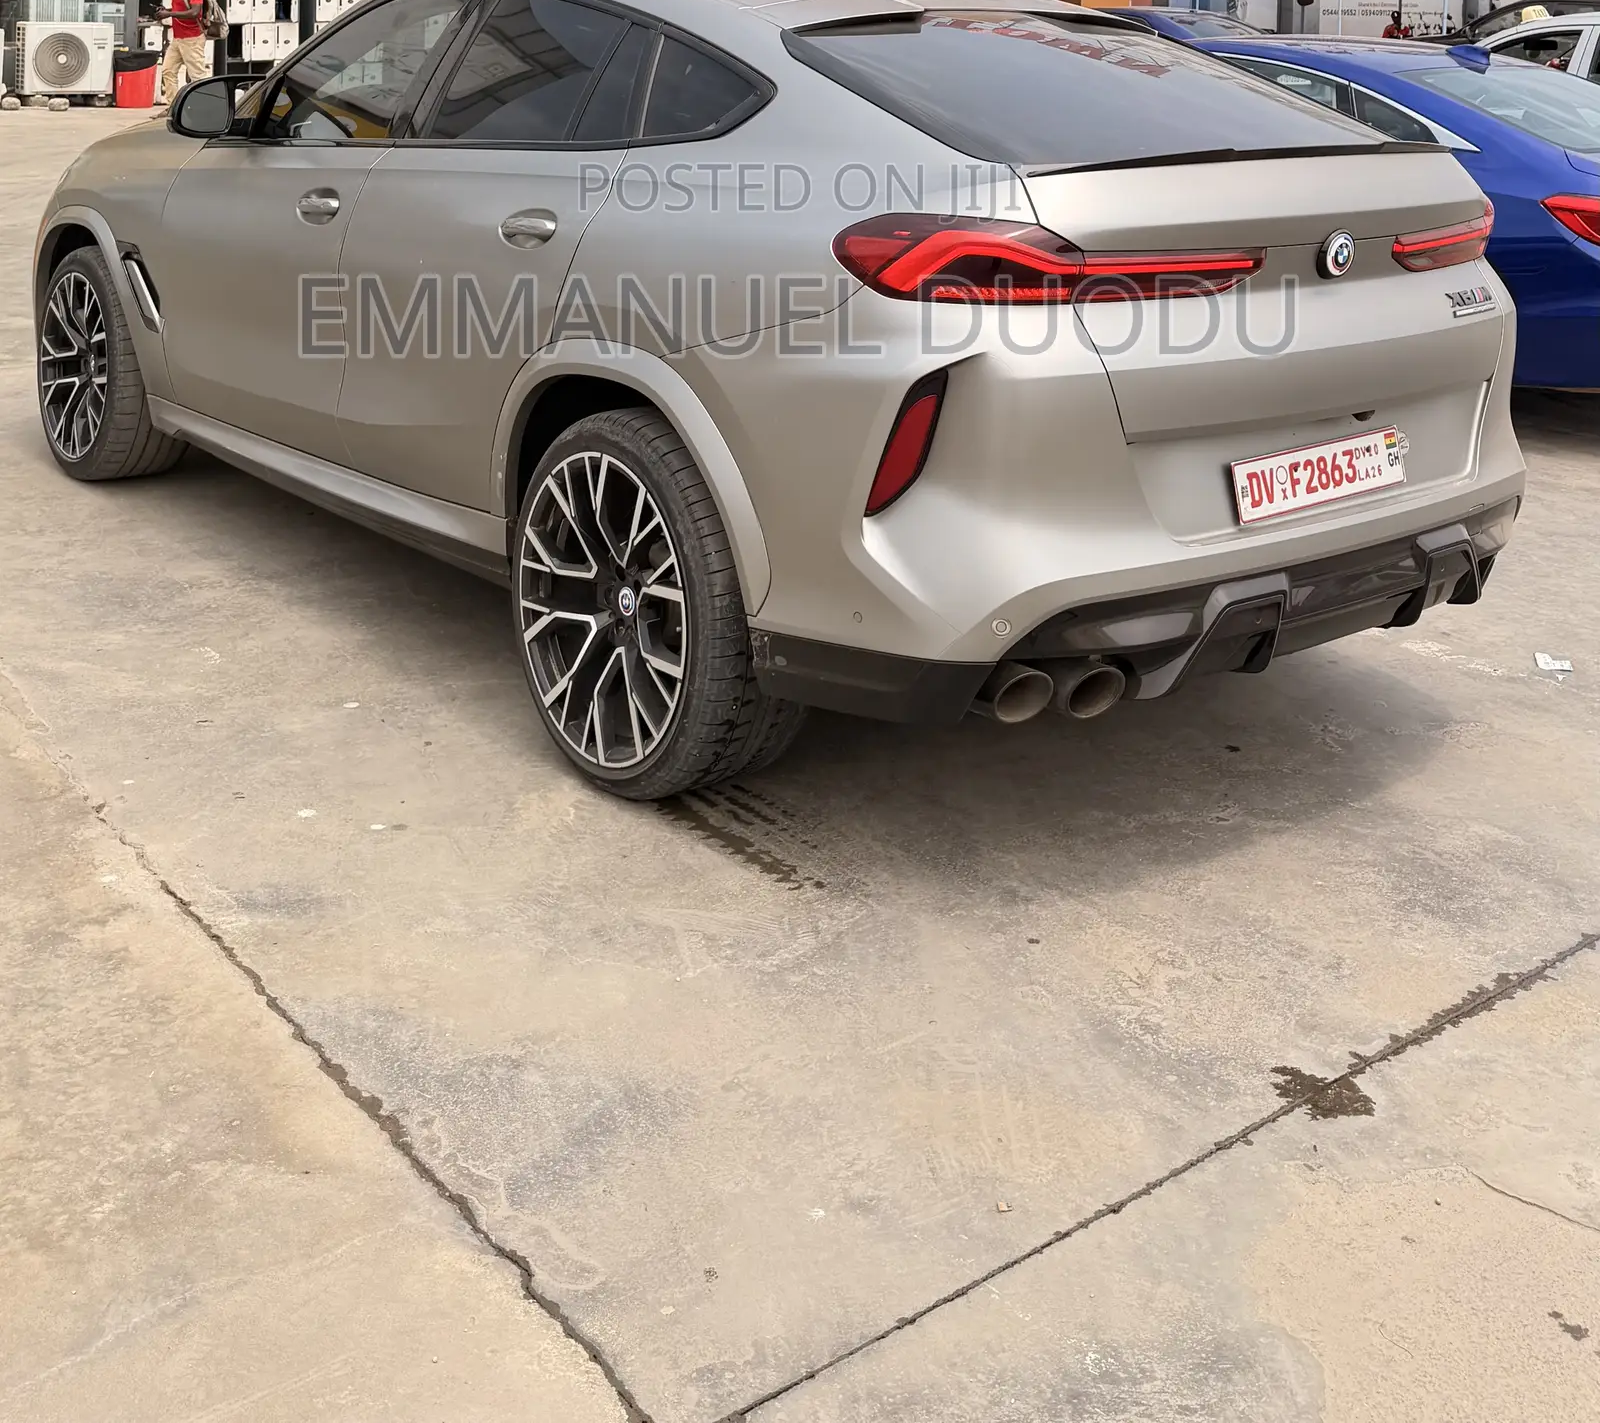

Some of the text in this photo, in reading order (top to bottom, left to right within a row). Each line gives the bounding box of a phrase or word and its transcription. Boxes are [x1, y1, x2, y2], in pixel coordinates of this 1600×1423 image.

[1322, 8, 1357, 16] 054419552
[1387, 451, 1401, 467] GH
[1246, 468, 1275, 509] DV
[1288, 448, 1358, 498] F2863
[1357, 464, 1383, 481] LA26
